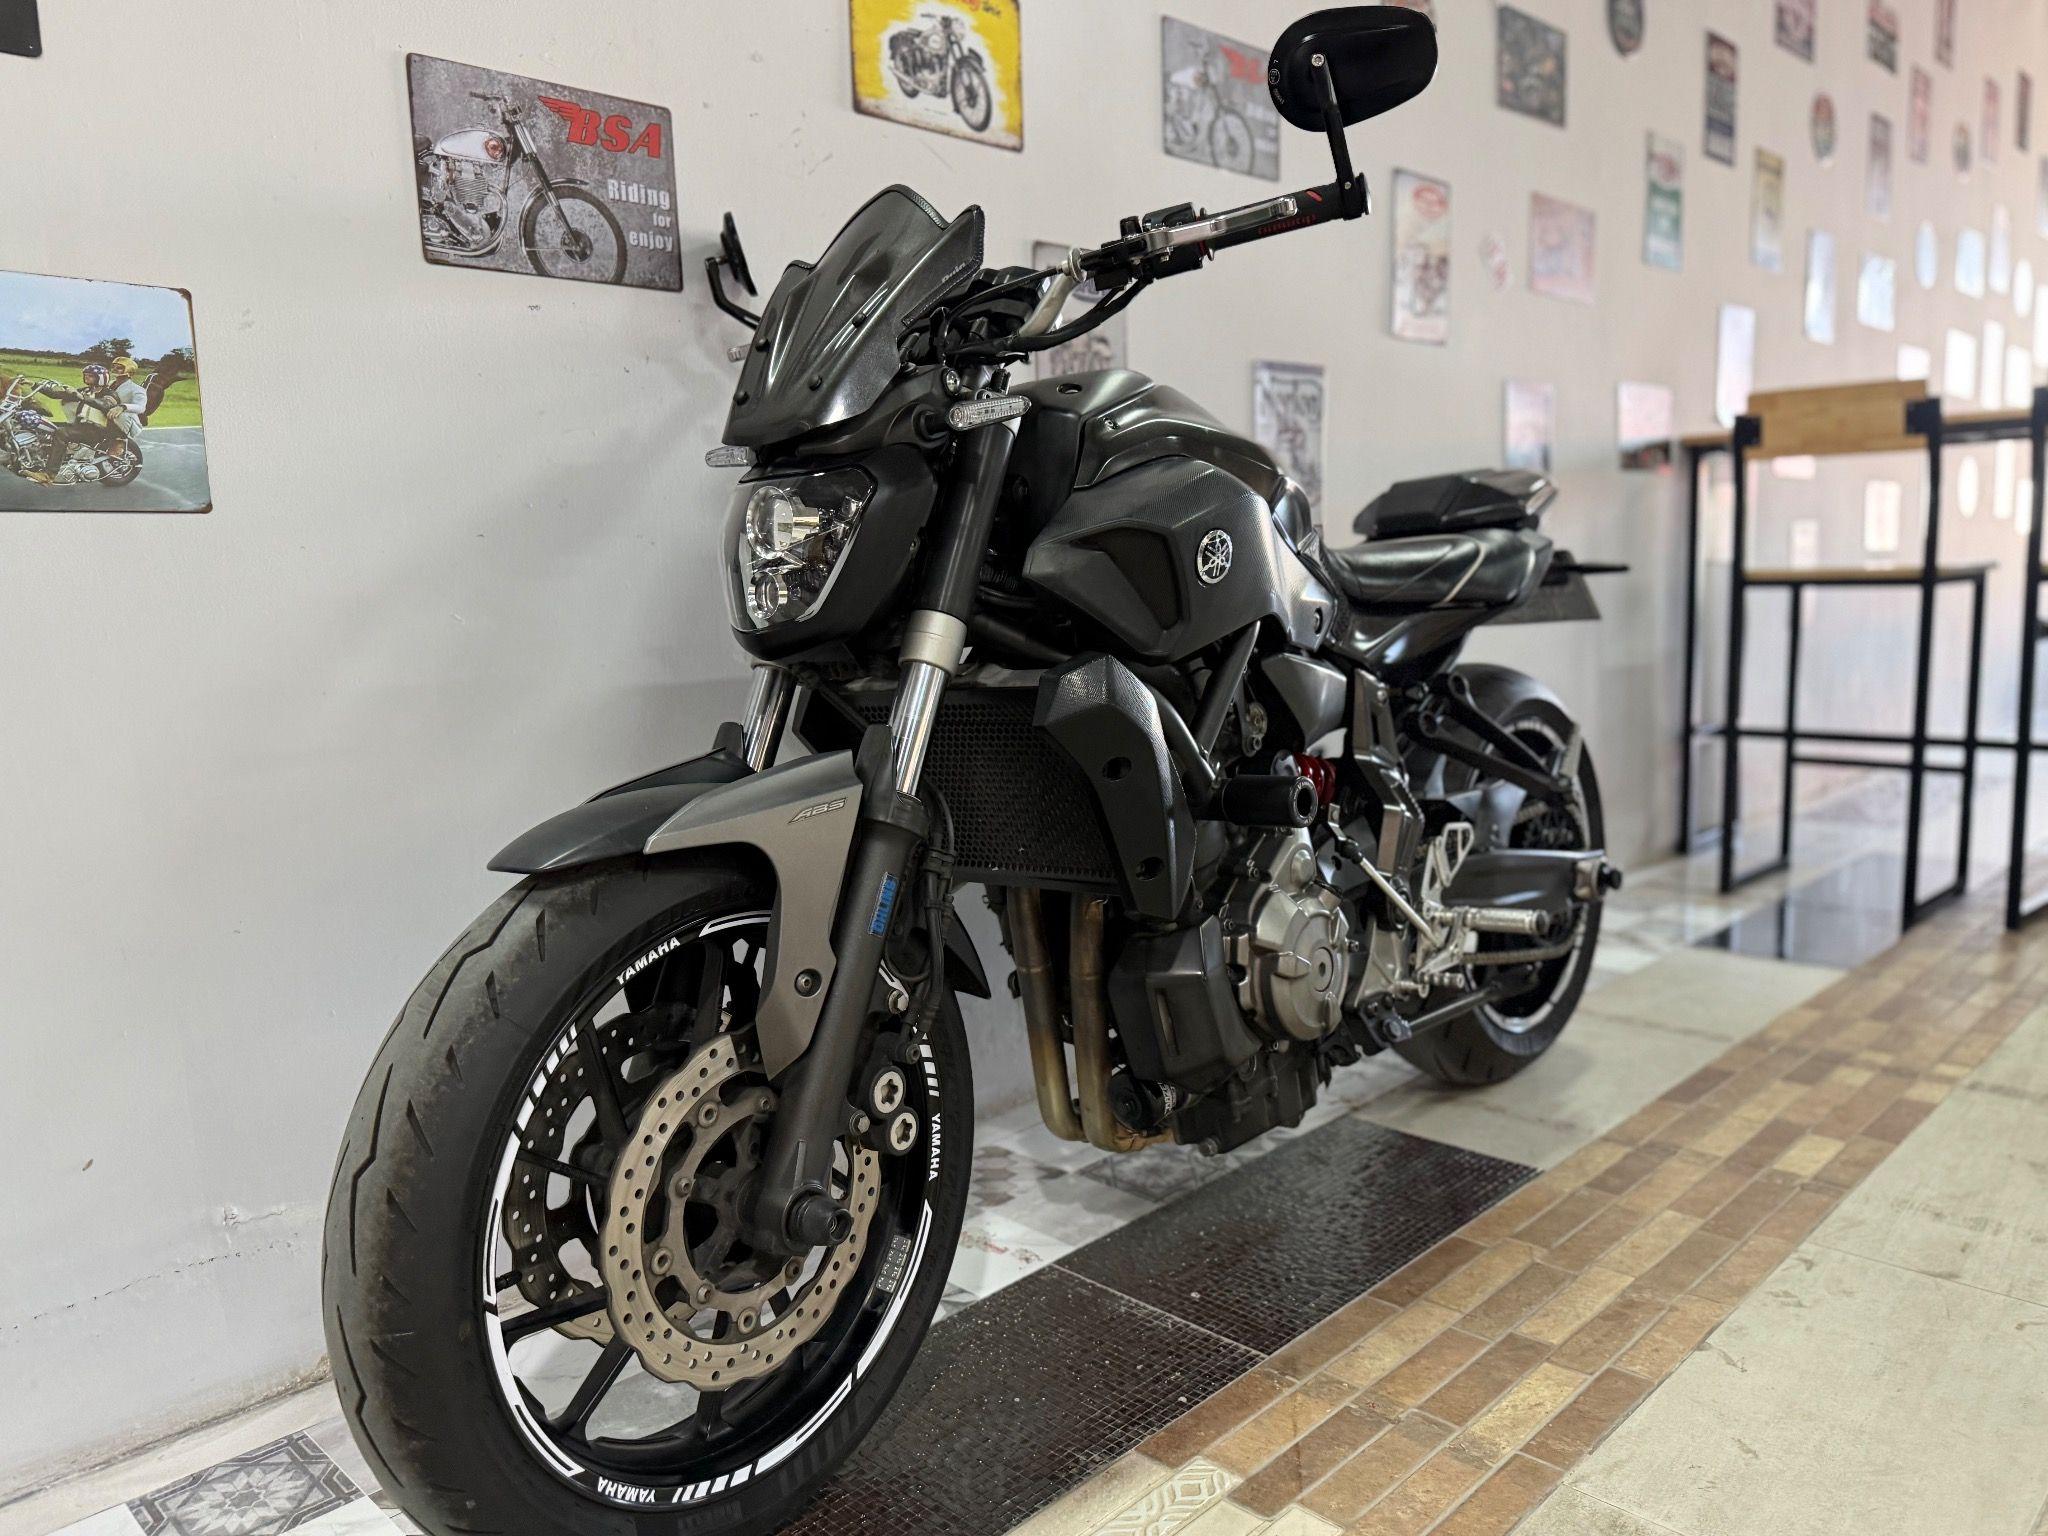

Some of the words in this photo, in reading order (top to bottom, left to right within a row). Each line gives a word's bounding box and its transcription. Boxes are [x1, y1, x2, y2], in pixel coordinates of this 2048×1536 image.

[566, 106, 662, 160] BSA
[607, 178, 671, 211] Riding
[652, 213, 672, 229] for
[629, 230, 673, 253] enjoy
[787, 797, 847, 823] ABS
[616, 937, 680, 985] YAMAHA
[928, 1112, 941, 1182] YAMAHA
[597, 1475, 656, 1504] YAMAHA
